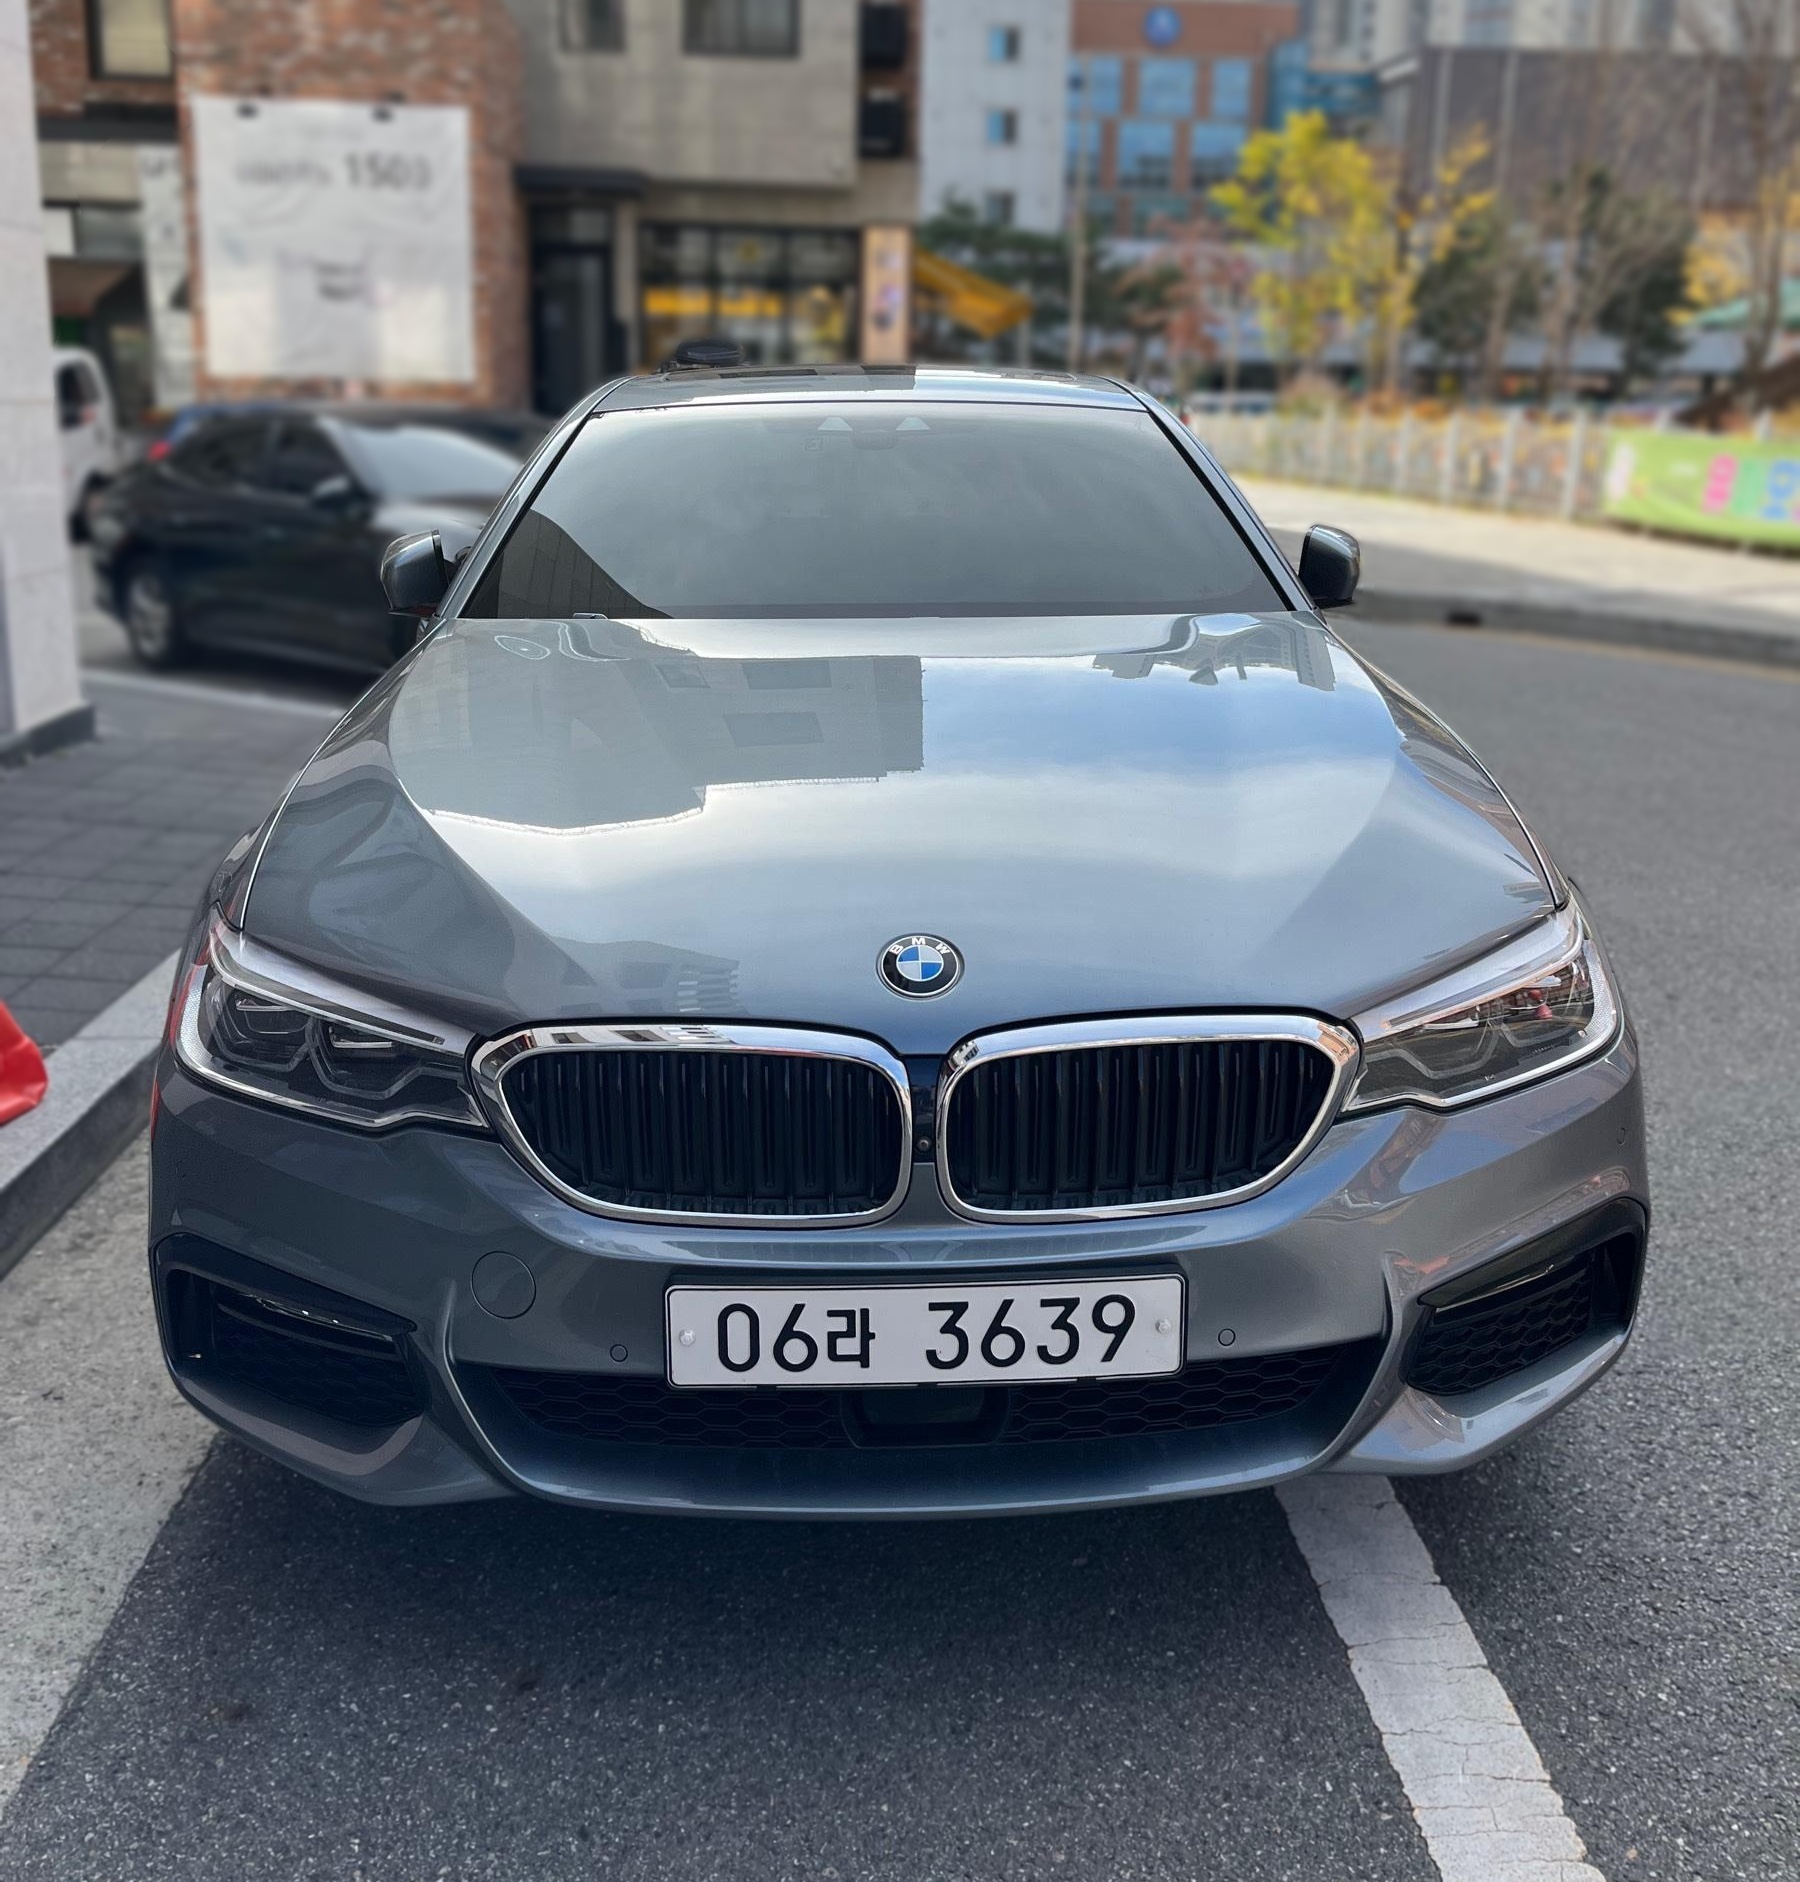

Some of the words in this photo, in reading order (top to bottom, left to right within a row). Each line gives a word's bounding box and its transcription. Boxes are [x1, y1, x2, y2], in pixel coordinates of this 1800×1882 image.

[889, 937, 950, 955] BMW
[716, 1302, 876, 1373] 06라
[925, 1293, 1136, 1370] 3639
